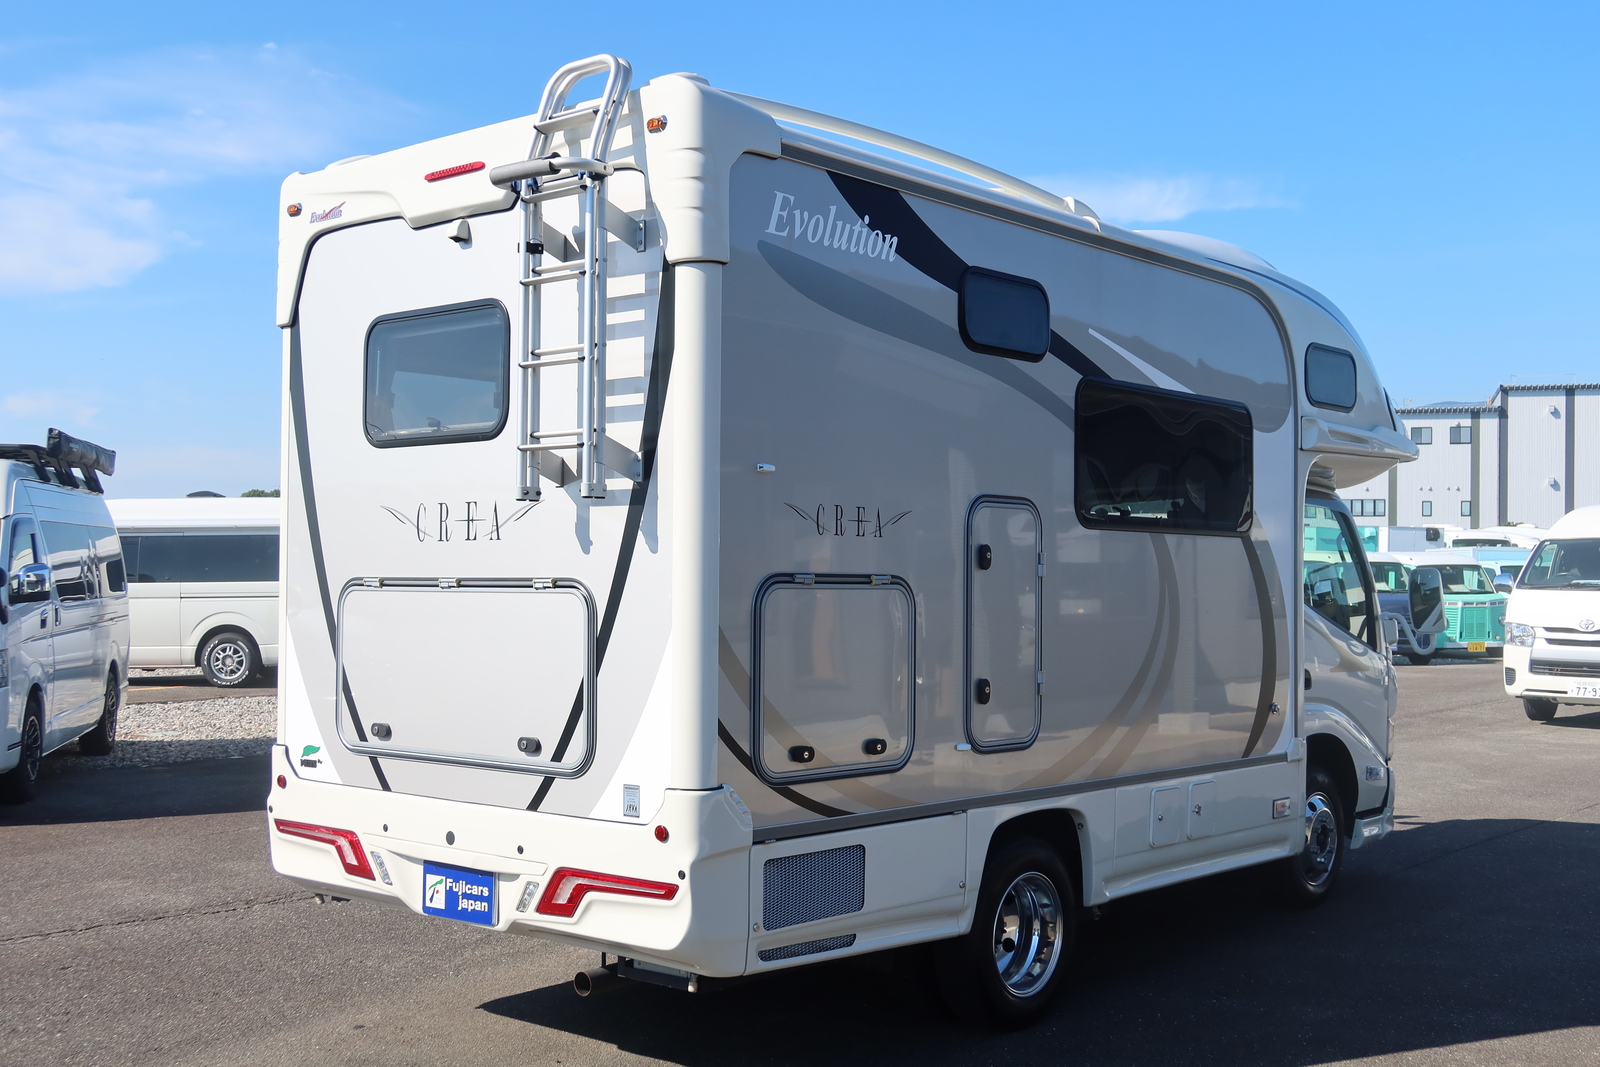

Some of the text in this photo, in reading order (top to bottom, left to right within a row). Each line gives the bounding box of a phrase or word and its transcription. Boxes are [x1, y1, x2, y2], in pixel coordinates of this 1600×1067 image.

[765, 190, 899, 262] Evolution
[416, 500, 502, 542] CREA
[816, 503, 883, 538] CREA
[458, 895, 489, 912] japan
